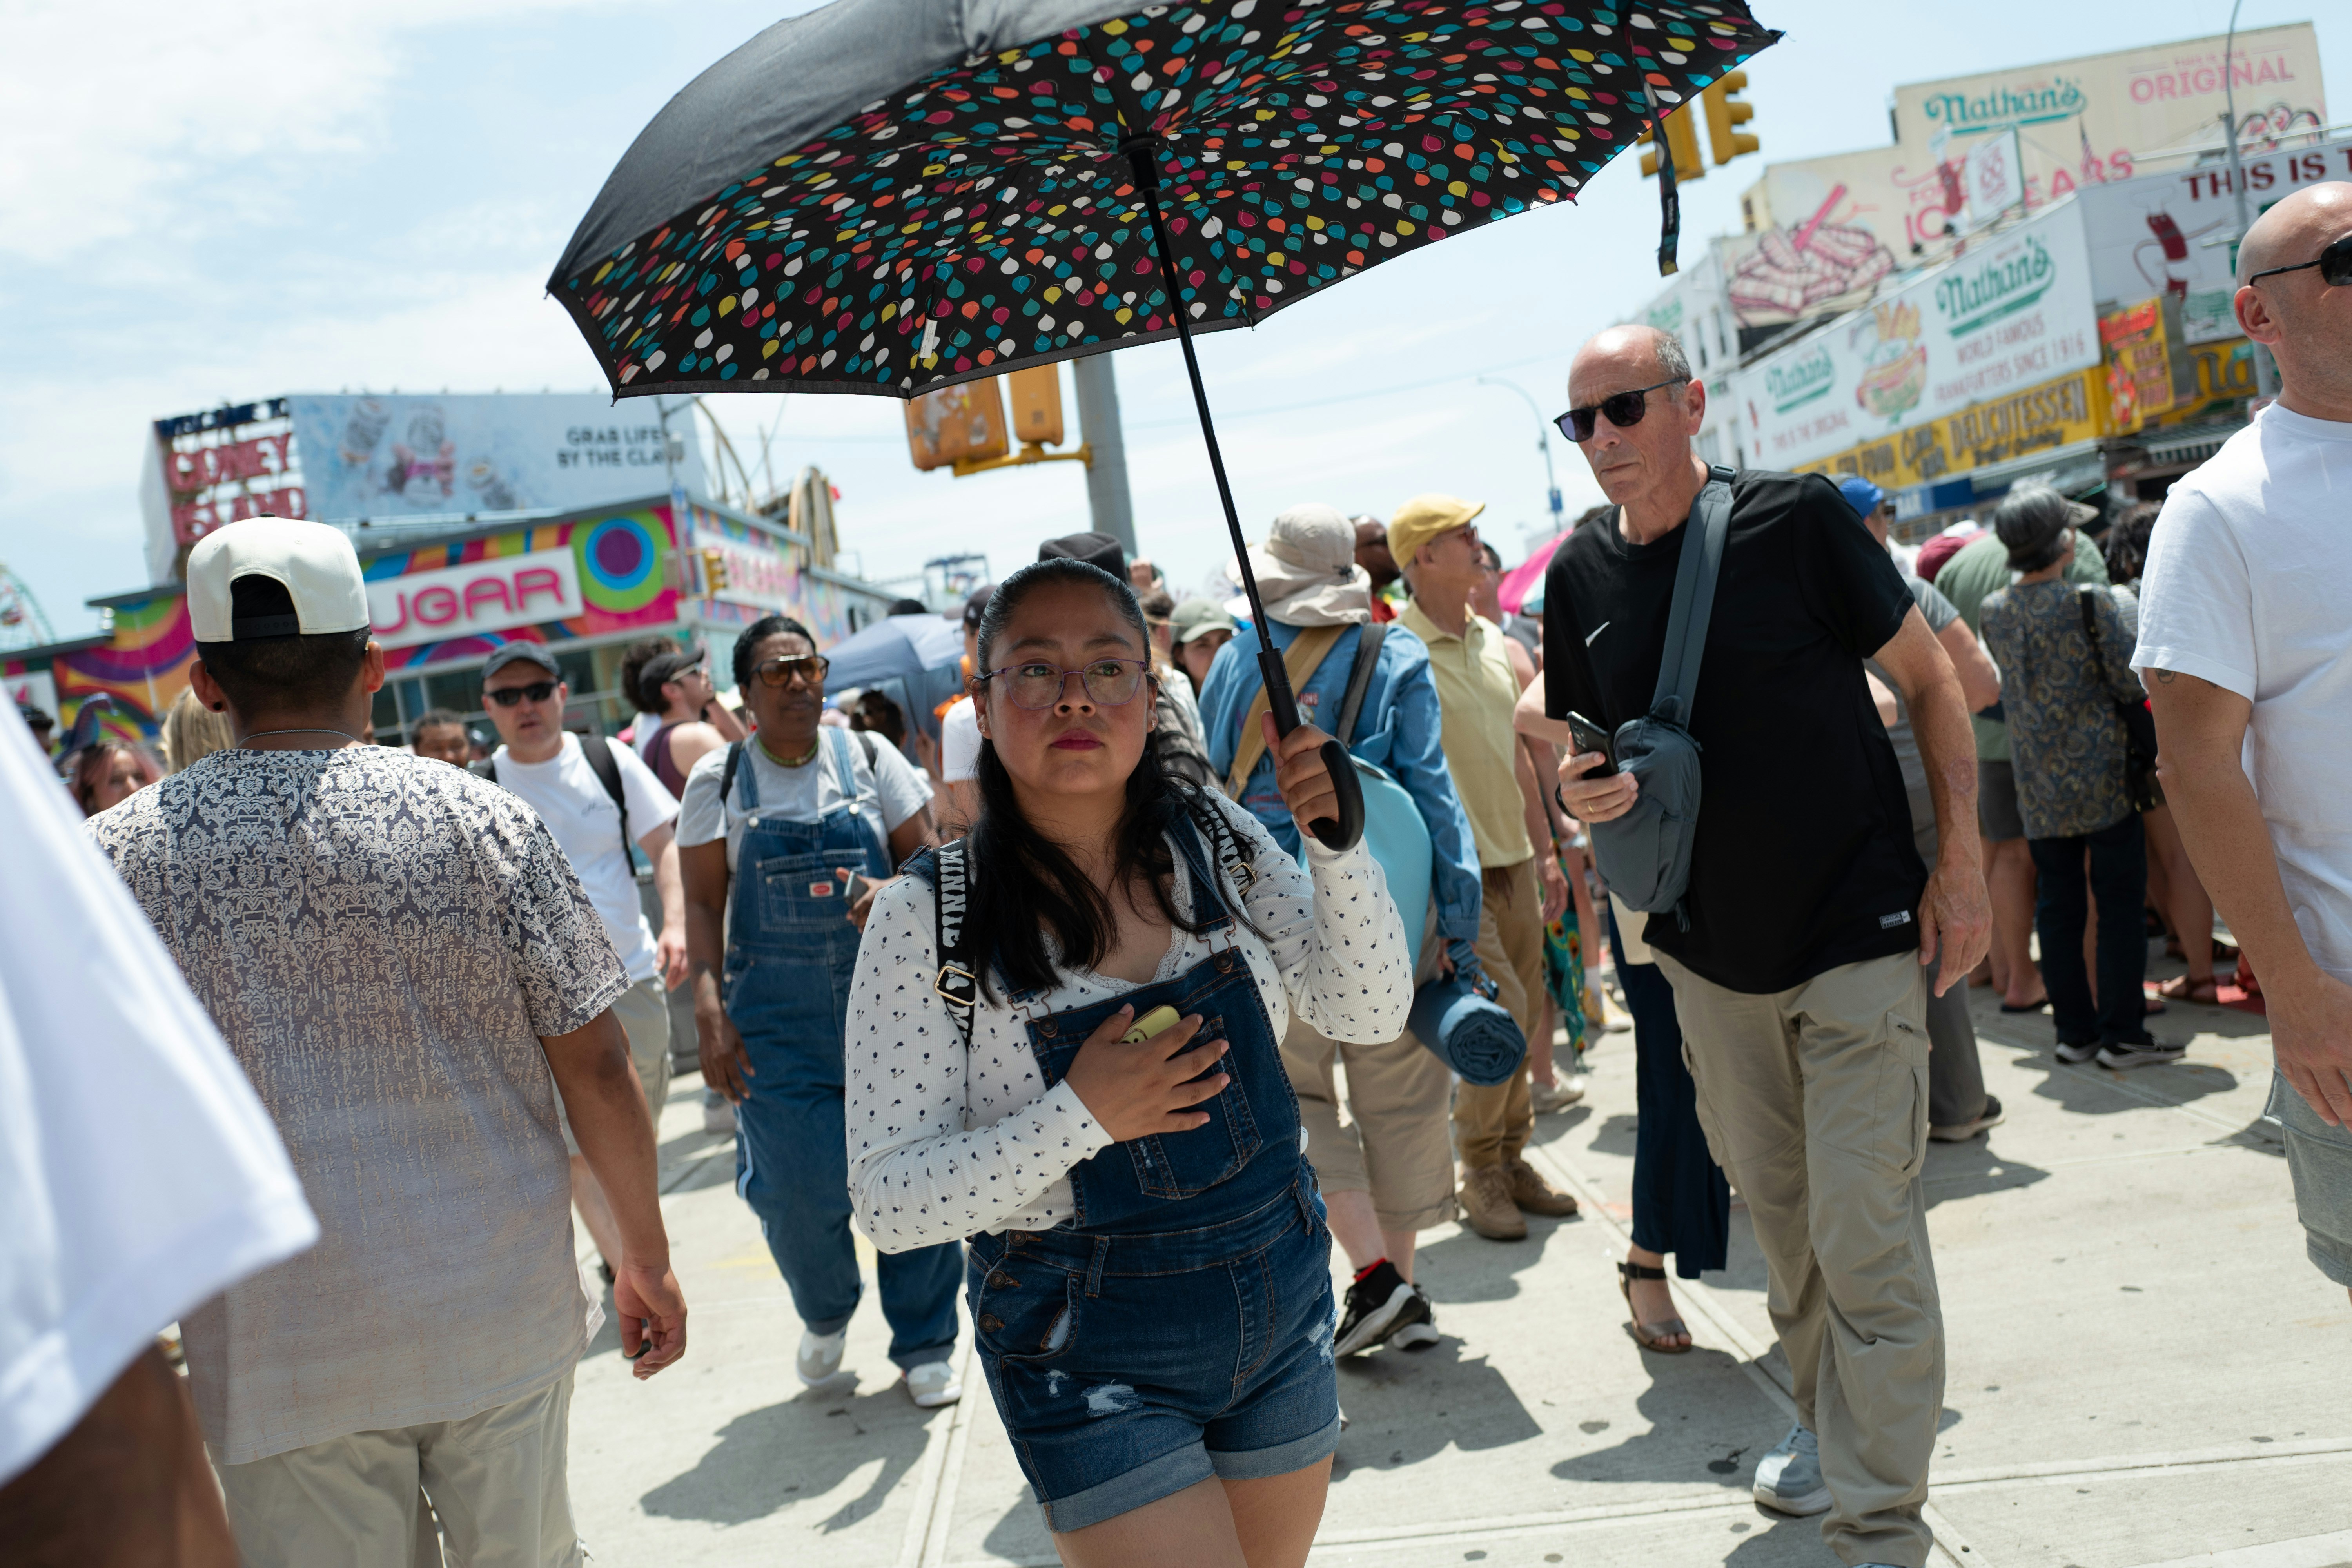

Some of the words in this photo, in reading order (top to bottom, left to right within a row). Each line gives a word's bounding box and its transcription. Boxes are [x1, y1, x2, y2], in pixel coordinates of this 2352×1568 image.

[1924, 76, 2085, 125] Nathan's
[2129, 55, 2294, 103] ORIGINAL
[2025, 148, 2133, 209] EARS
[2181, 162, 2274, 201] THIS
[2288, 153, 2326, 183] IS
[1936, 235, 2052, 318] Nathan's
[1957, 335, 1993, 363] WORLD
[568, 426, 621, 445] GRAB
[626, 426, 661, 445] LIFE
[1950, 378, 2088, 459] DELICATESSEN
[167, 432, 292, 492] CONEY
[557, 450, 580, 468] BY
[587, 450, 621, 467] THE
[627, 449, 680, 466] CLA
[368, 566, 564, 636] UGAR
[939, 849, 967, 948] MINNIE
